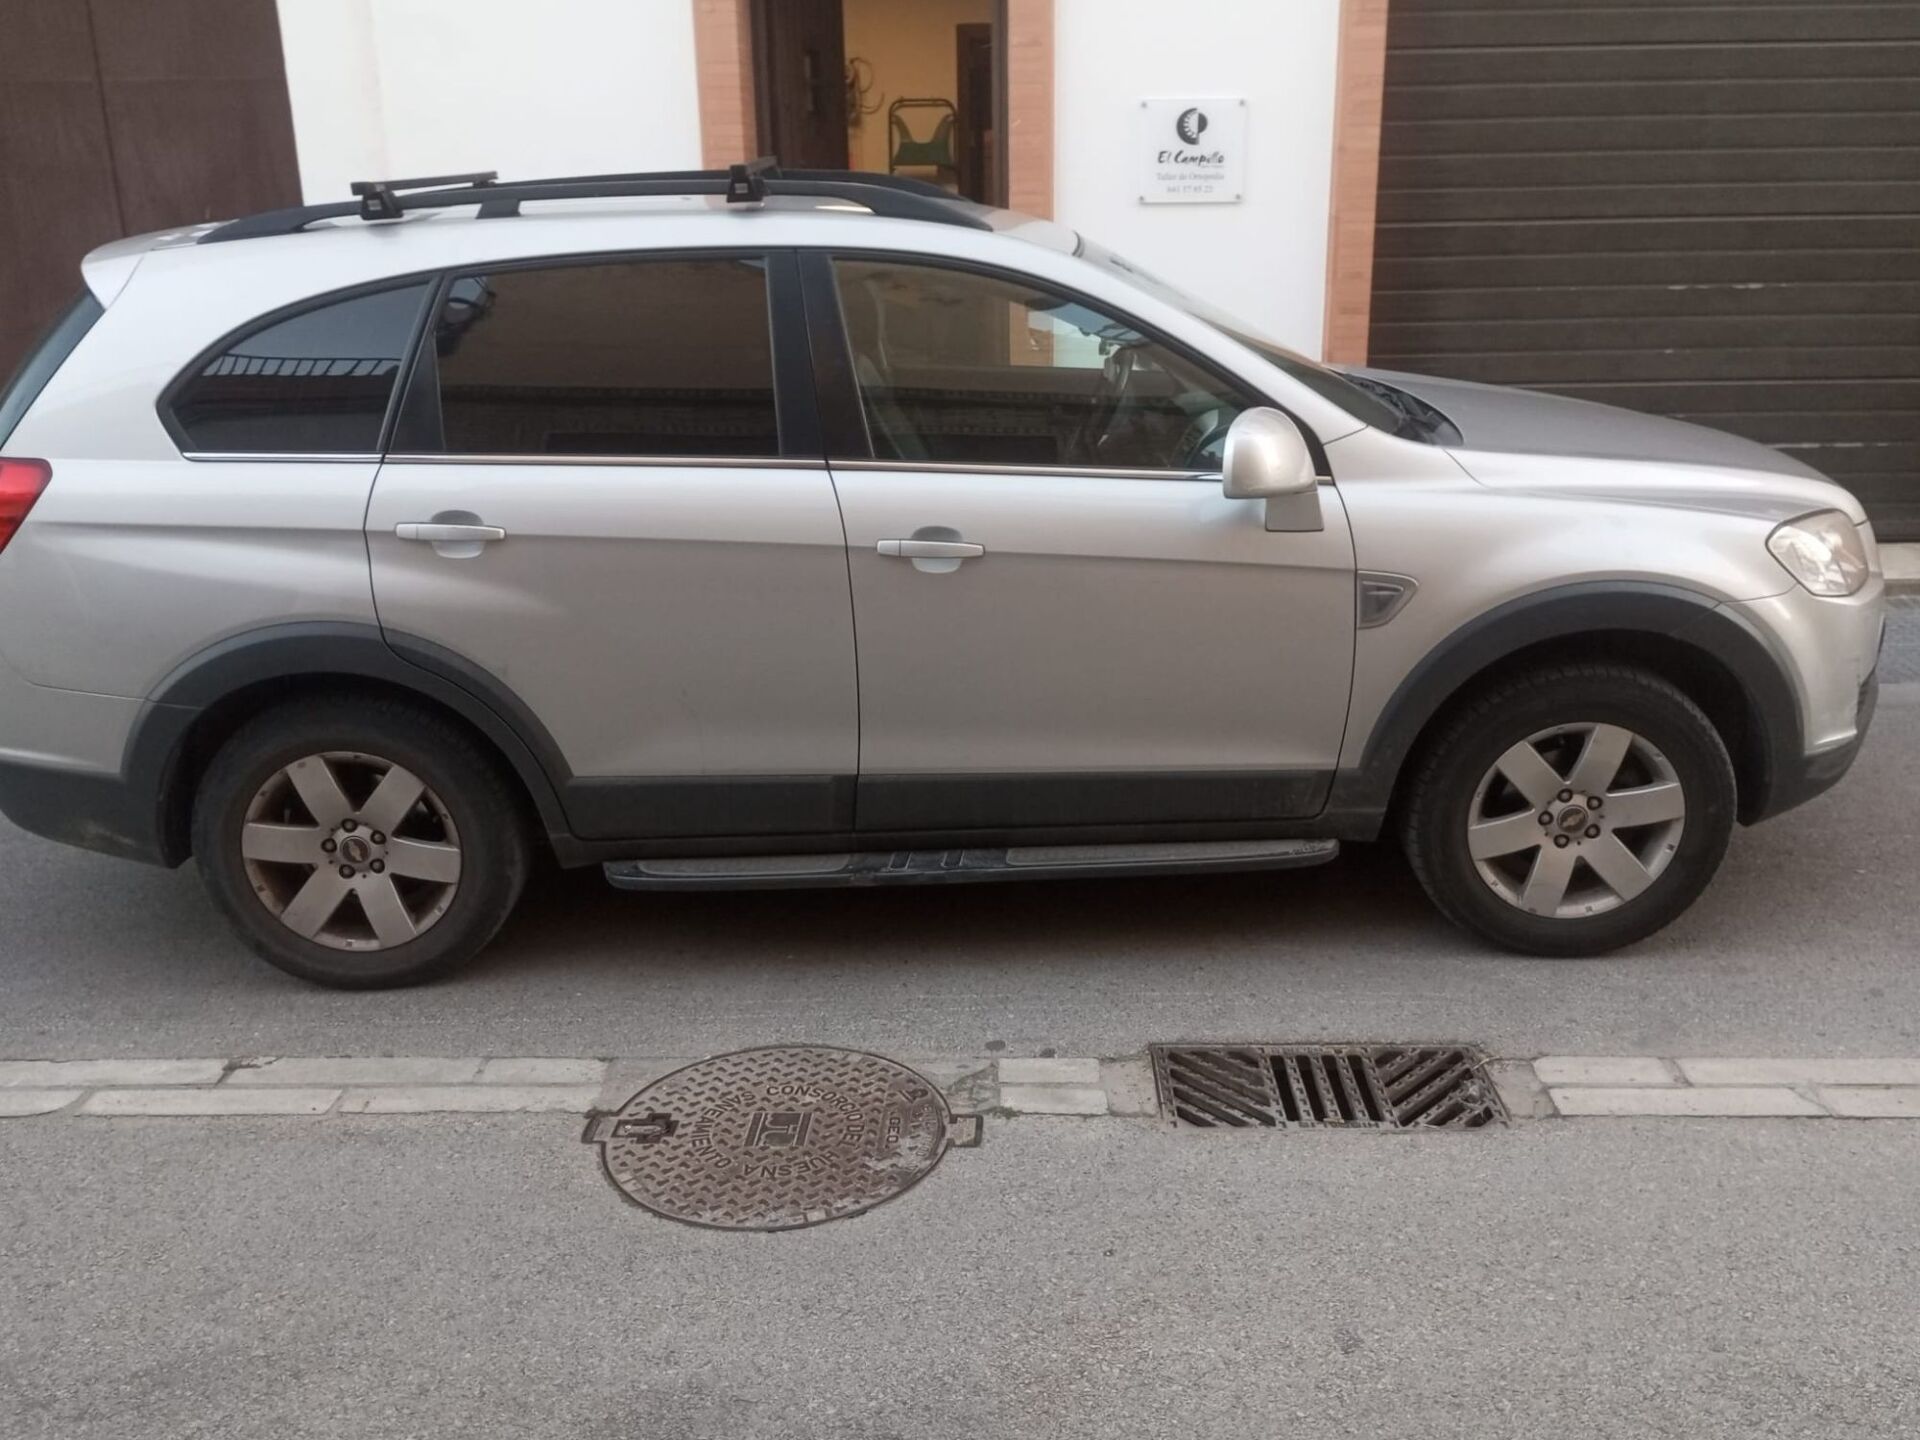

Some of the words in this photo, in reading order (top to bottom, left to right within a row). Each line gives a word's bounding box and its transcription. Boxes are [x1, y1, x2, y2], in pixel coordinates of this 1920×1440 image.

[1158, 150, 1172, 164] El
[766, 1085, 864, 1122] CONSORCIO
[691, 1091, 756, 1169] SANEAMIENTO
[837, 1124, 865, 1149] DEL
[744, 1150, 840, 1178] HUESNA
